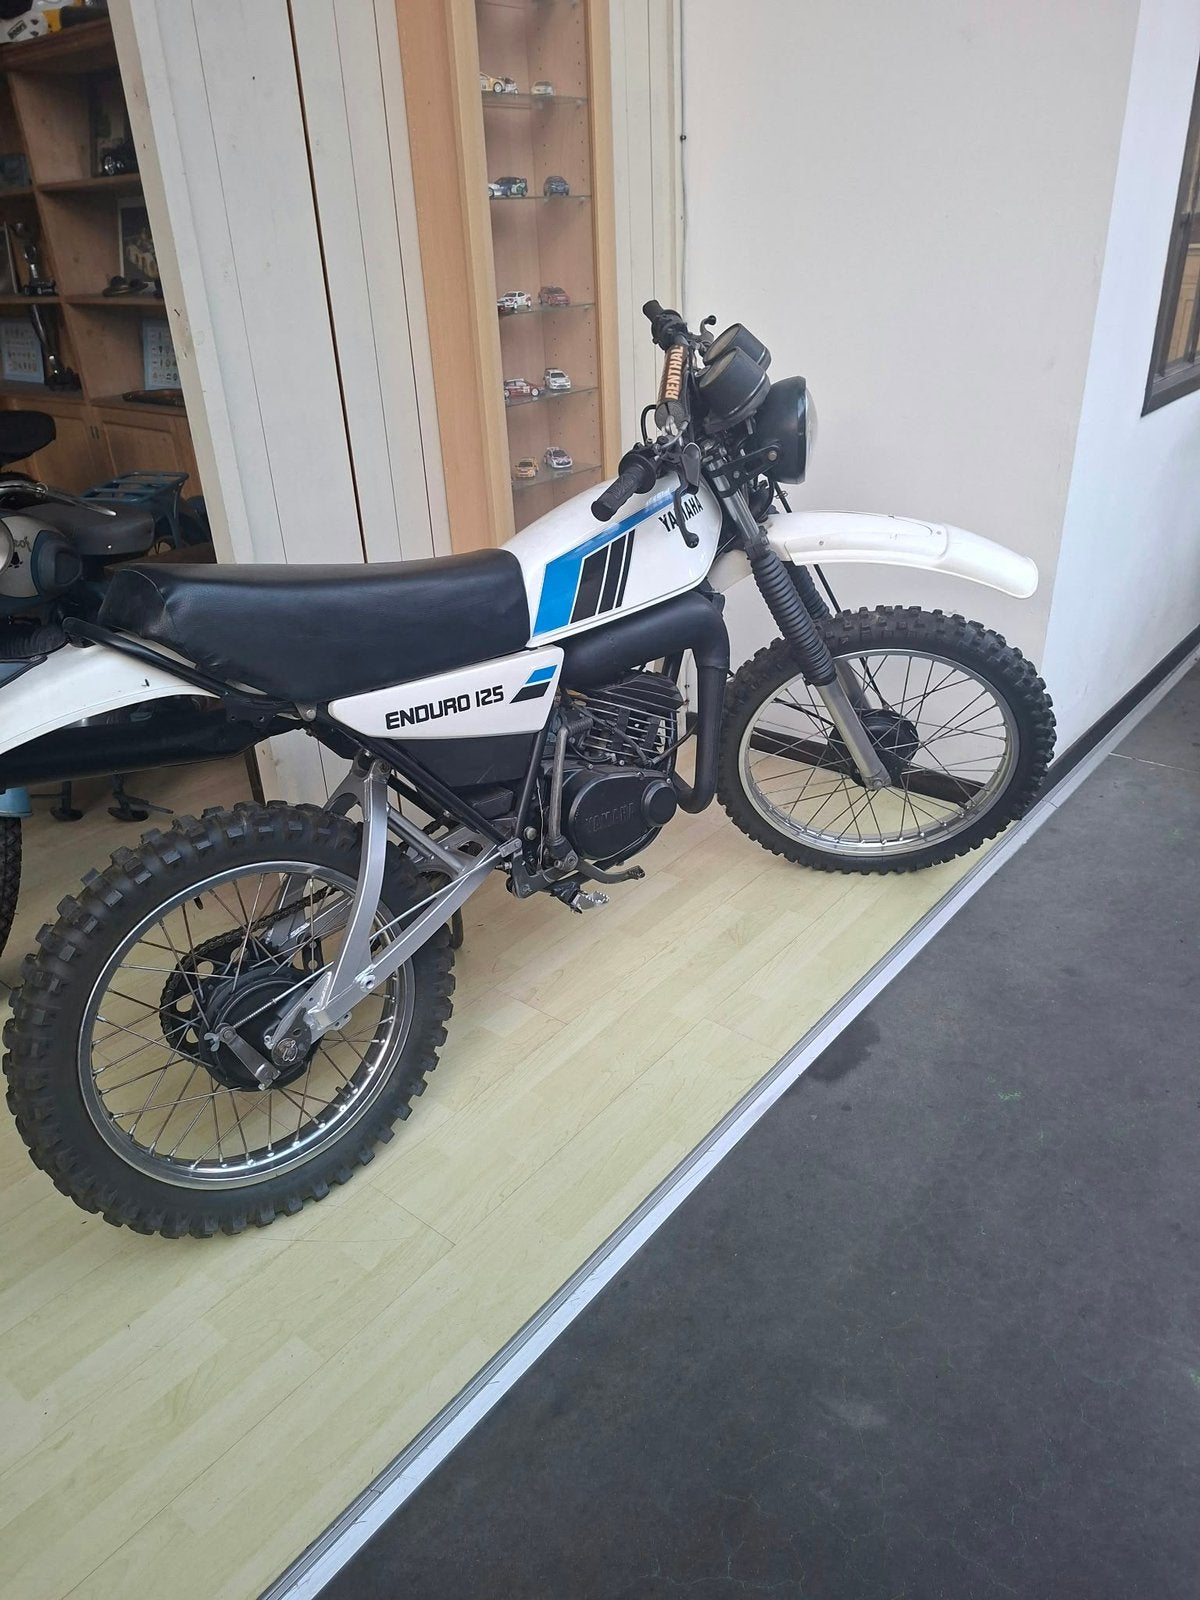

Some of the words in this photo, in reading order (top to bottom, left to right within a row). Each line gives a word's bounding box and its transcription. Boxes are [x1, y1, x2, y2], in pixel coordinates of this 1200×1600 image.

[665, 346, 684, 400] RENTHAL
[385, 693, 471, 730] ENDURO
[475, 685, 505, 708] 125
